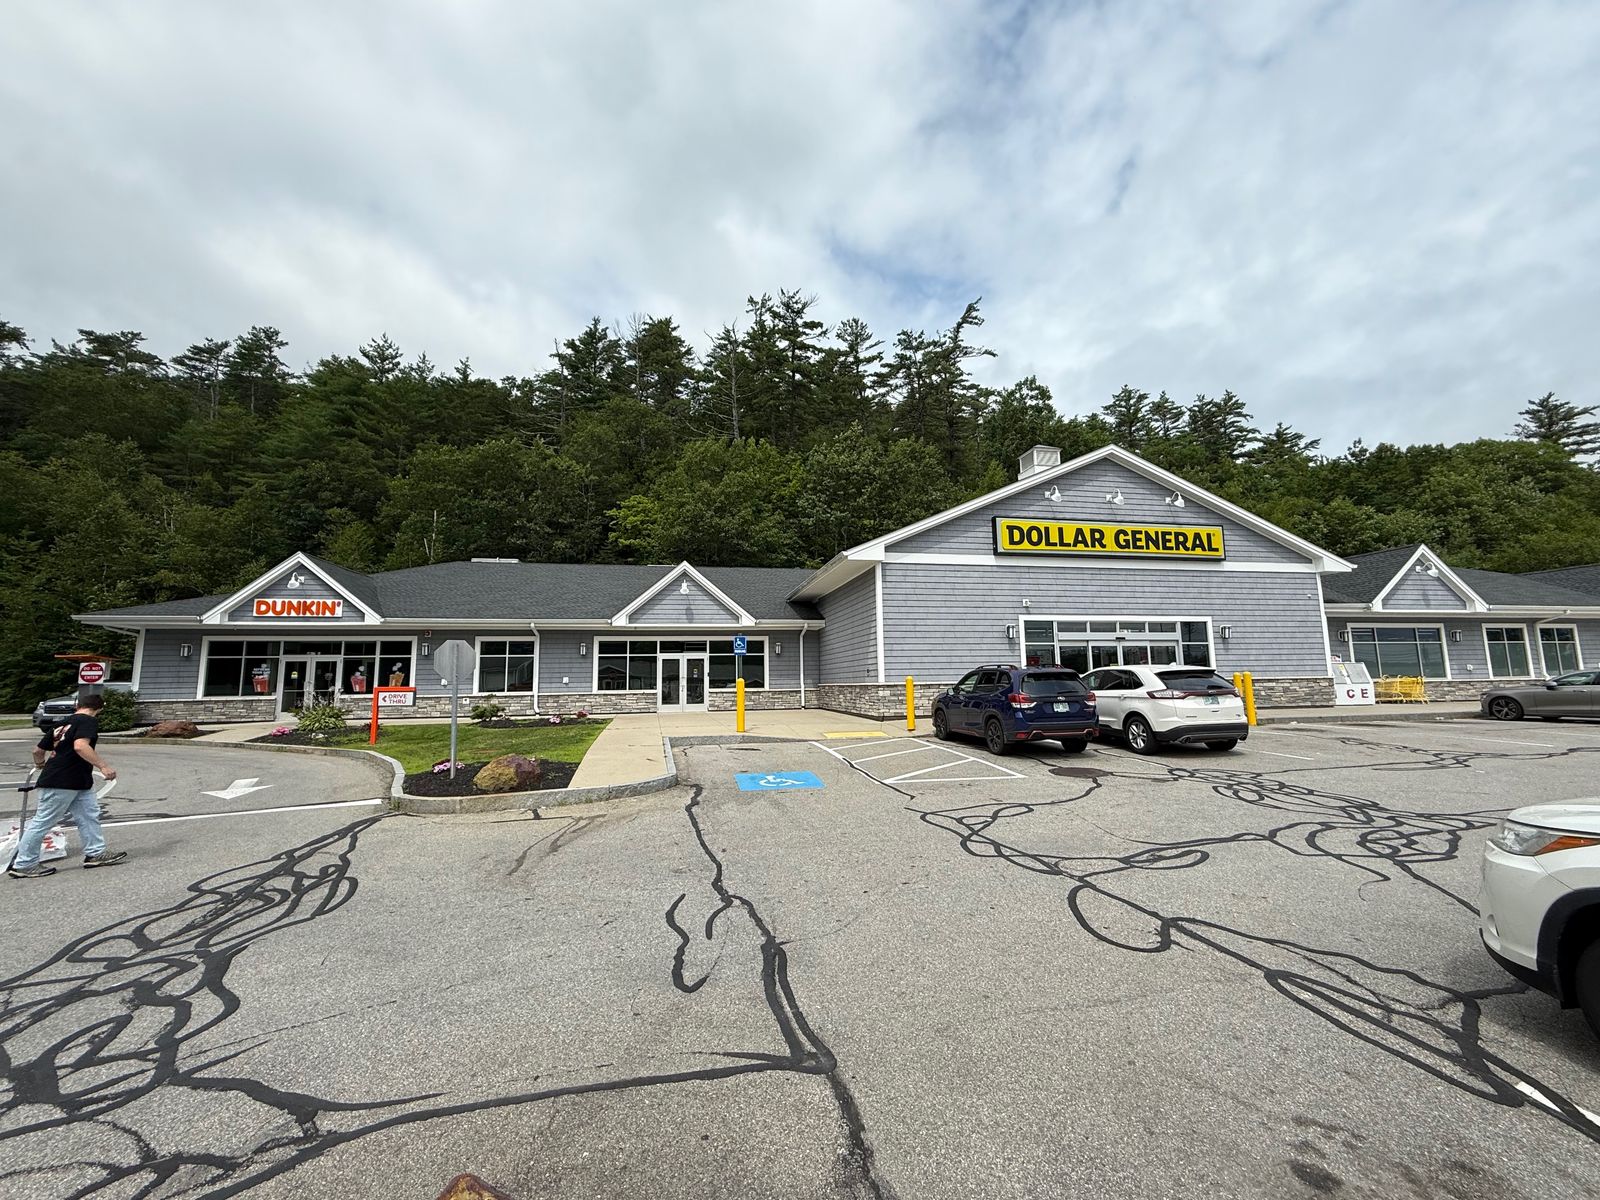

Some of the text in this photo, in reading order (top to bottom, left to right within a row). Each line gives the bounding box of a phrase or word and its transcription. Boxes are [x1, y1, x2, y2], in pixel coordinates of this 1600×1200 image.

[1006, 525, 1219, 552] DOLLAR GENERAL
[255, 600, 341, 616] DUNKIN'
